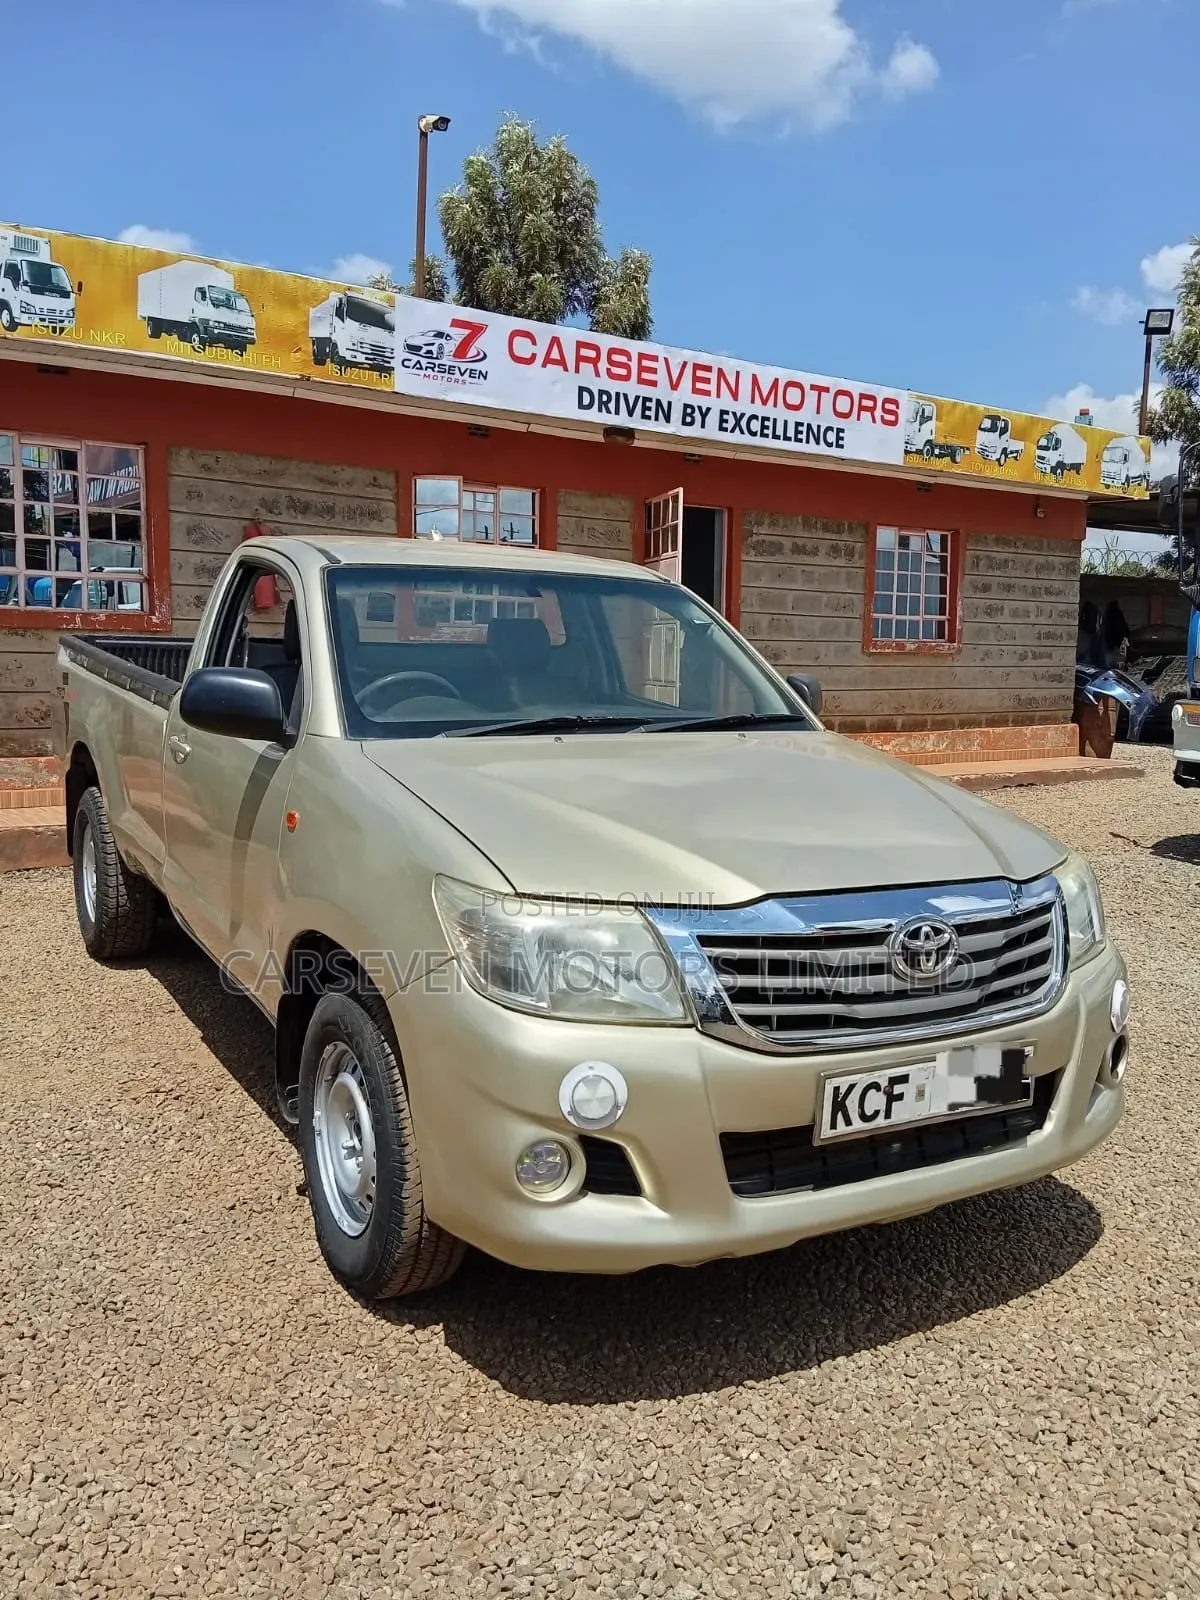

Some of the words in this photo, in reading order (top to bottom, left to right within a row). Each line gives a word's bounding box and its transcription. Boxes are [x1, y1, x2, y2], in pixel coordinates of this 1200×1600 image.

[31, 323, 83, 340] ISUZU
[89, 328, 127, 346] NKR
[166, 340, 257, 365] MITSUBISHI
[328, 363, 369, 381] ISUZU
[401, 358, 488, 381] CARSEVEN
[423, 373, 467, 385] MOTORS
[507, 328, 740, 402] CARSEVEN
[750, 373, 900, 427] MOTORS
[577, 385, 672, 424] DRIVEN
[681, 403, 712, 429] BY
[718, 408, 846, 450] EXCELLENCE
[830, 1073, 910, 1131] KCF
